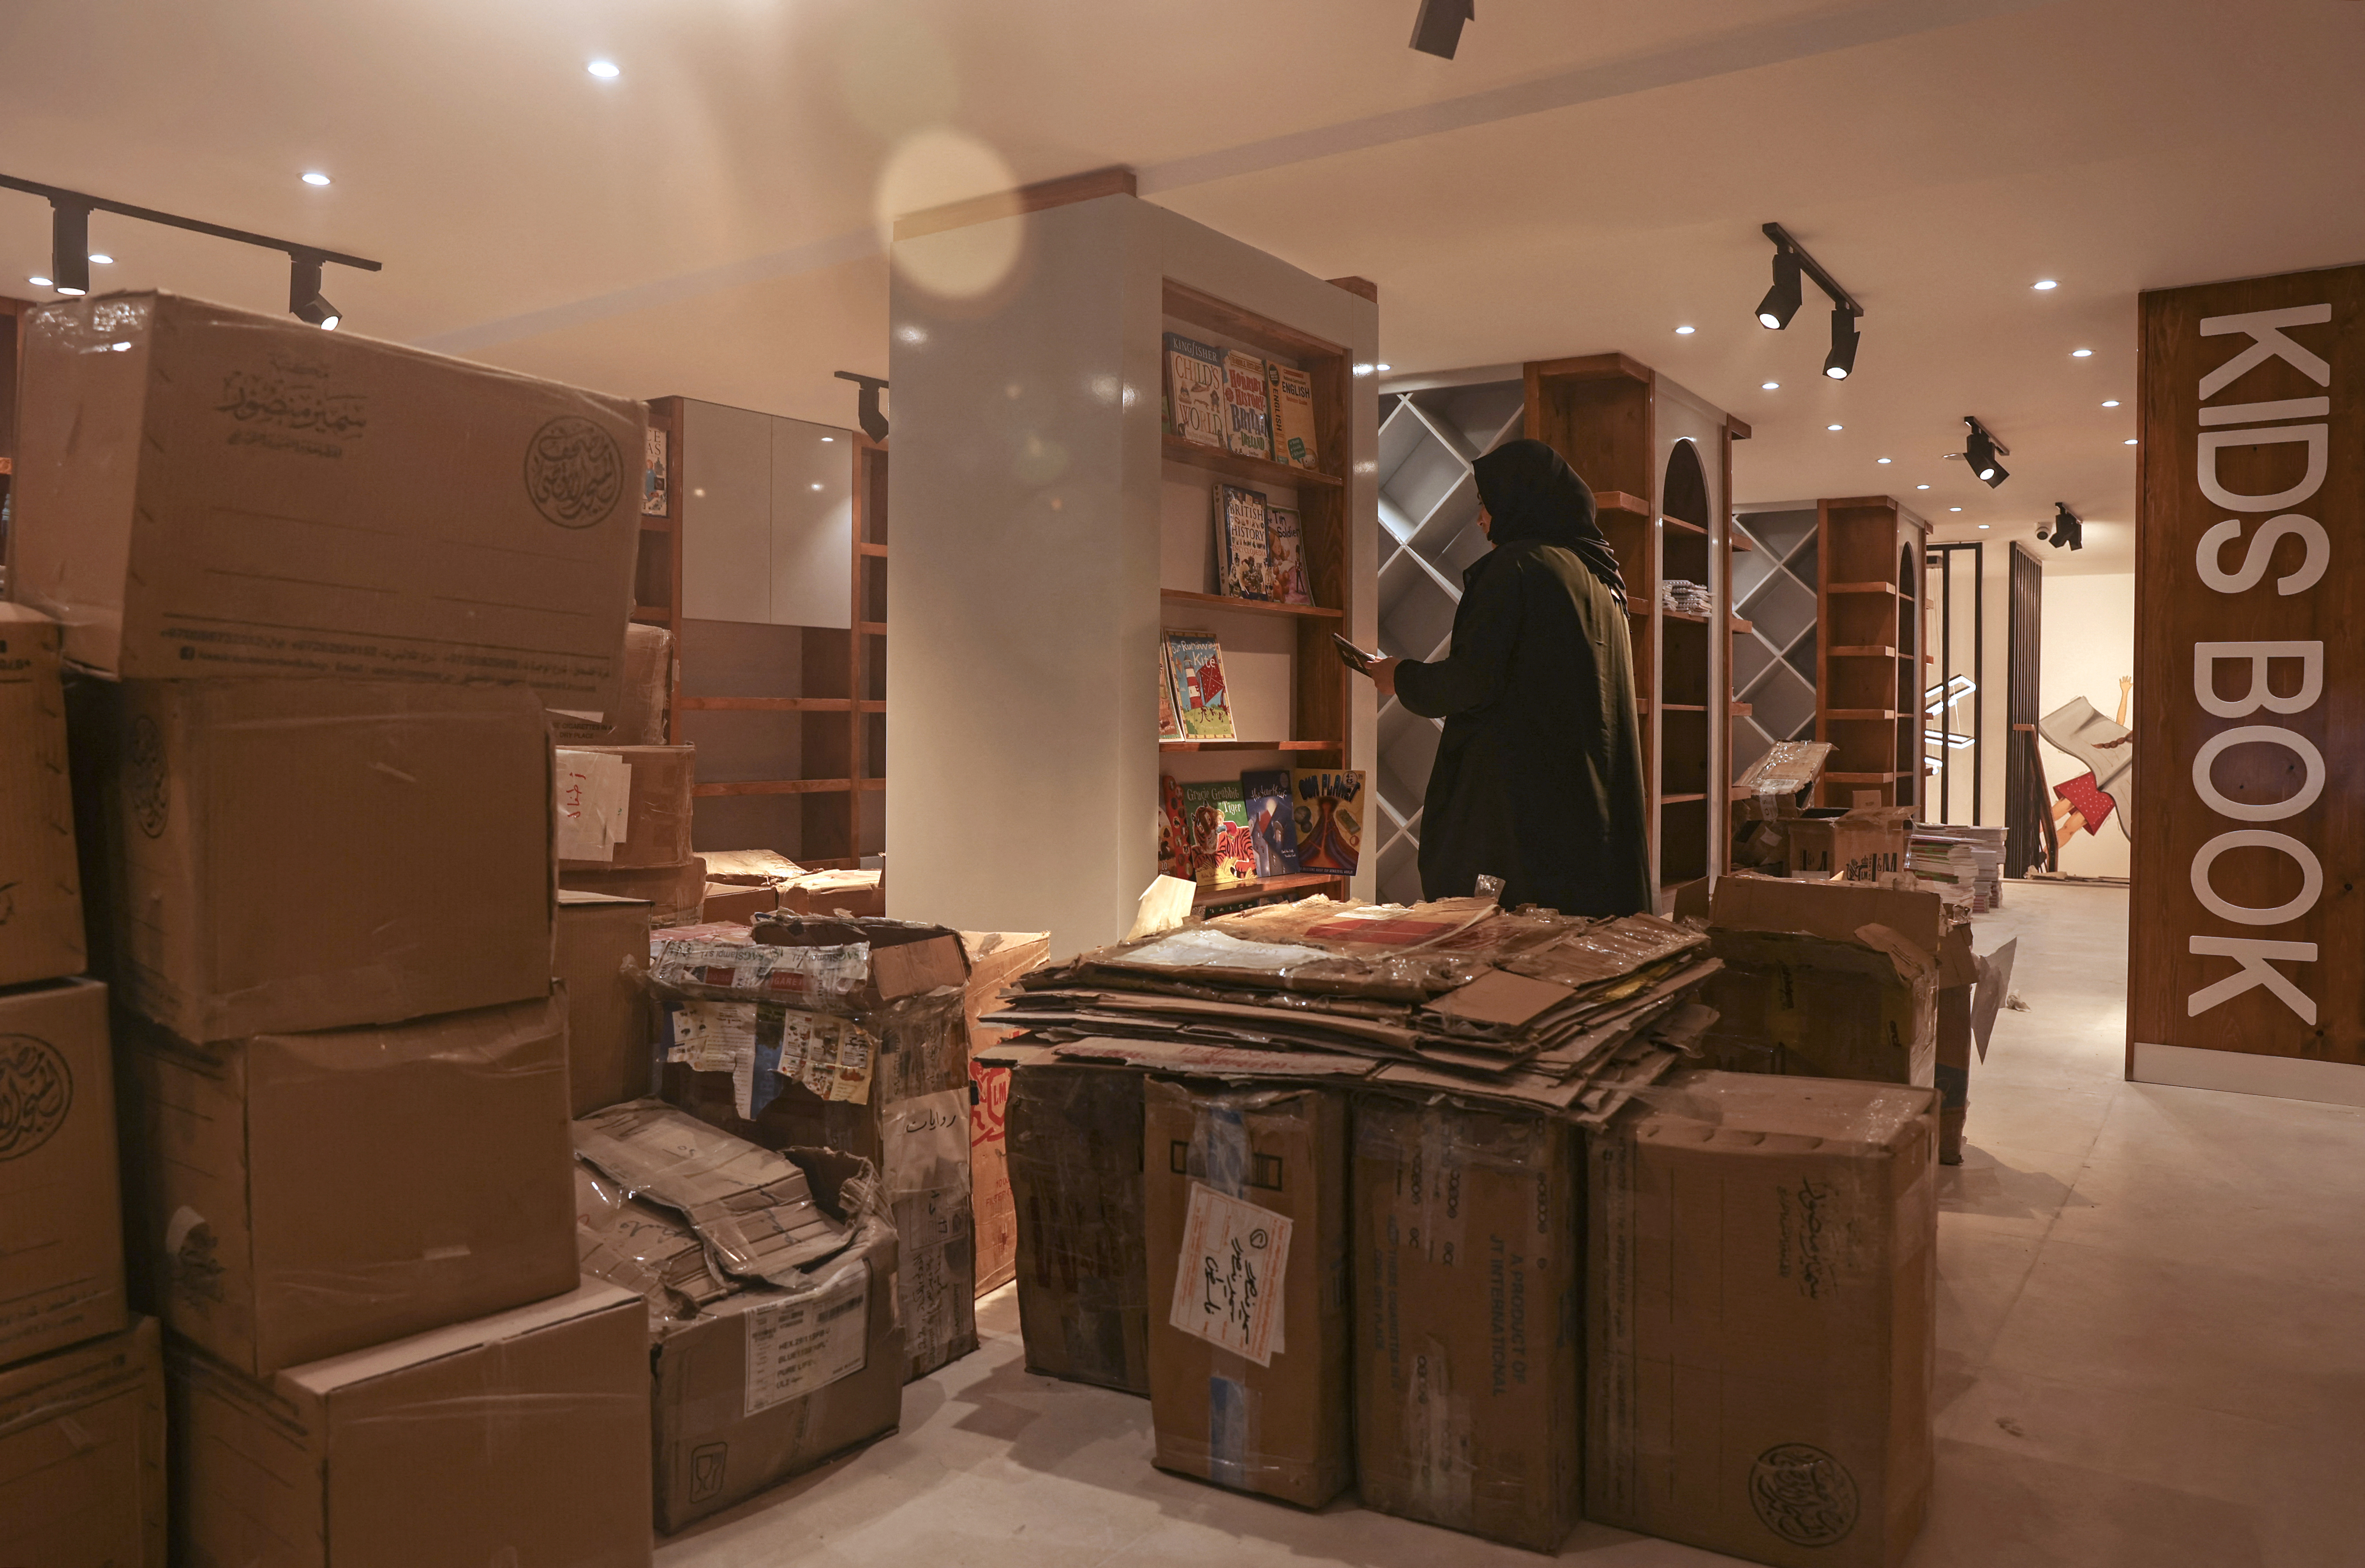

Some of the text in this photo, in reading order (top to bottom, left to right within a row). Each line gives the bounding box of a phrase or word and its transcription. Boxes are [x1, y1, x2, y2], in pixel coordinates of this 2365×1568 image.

[1282, 381, 1310, 399] ENGLISH
[1273, 388, 1282, 431] ENGLISH
[1179, 403, 1223, 436] WORLD
[1230, 503, 1263, 521] BRITISH
[1272, 510, 1287, 526] Tin
[1231, 525, 1264, 542] HISTORY
[1277, 526, 1300, 538] Soldier
[1232, 545, 1267, 557] ENCYCLOPEDIA
[1172, 640, 1218, 654] Our Runaway
[1193, 651, 1215, 668] Kite
[2188, 303, 2332, 1026] KIDS BOOK
[1187, 787, 1239, 801] Gracie Grabbit
[1222, 801, 1241, 815] Tiger
[1161, 862, 1168, 870] 10
[906, 1109, 956, 1133] روايات
[1204, 1256, 1224, 1315] فلسطين
[1244, 1260, 1258, 1308] منصور
[1490, 1233, 1507, 1397] JT INTERNATIONAL
[1511, 1254, 1526, 1385] A PRODUCT OF
